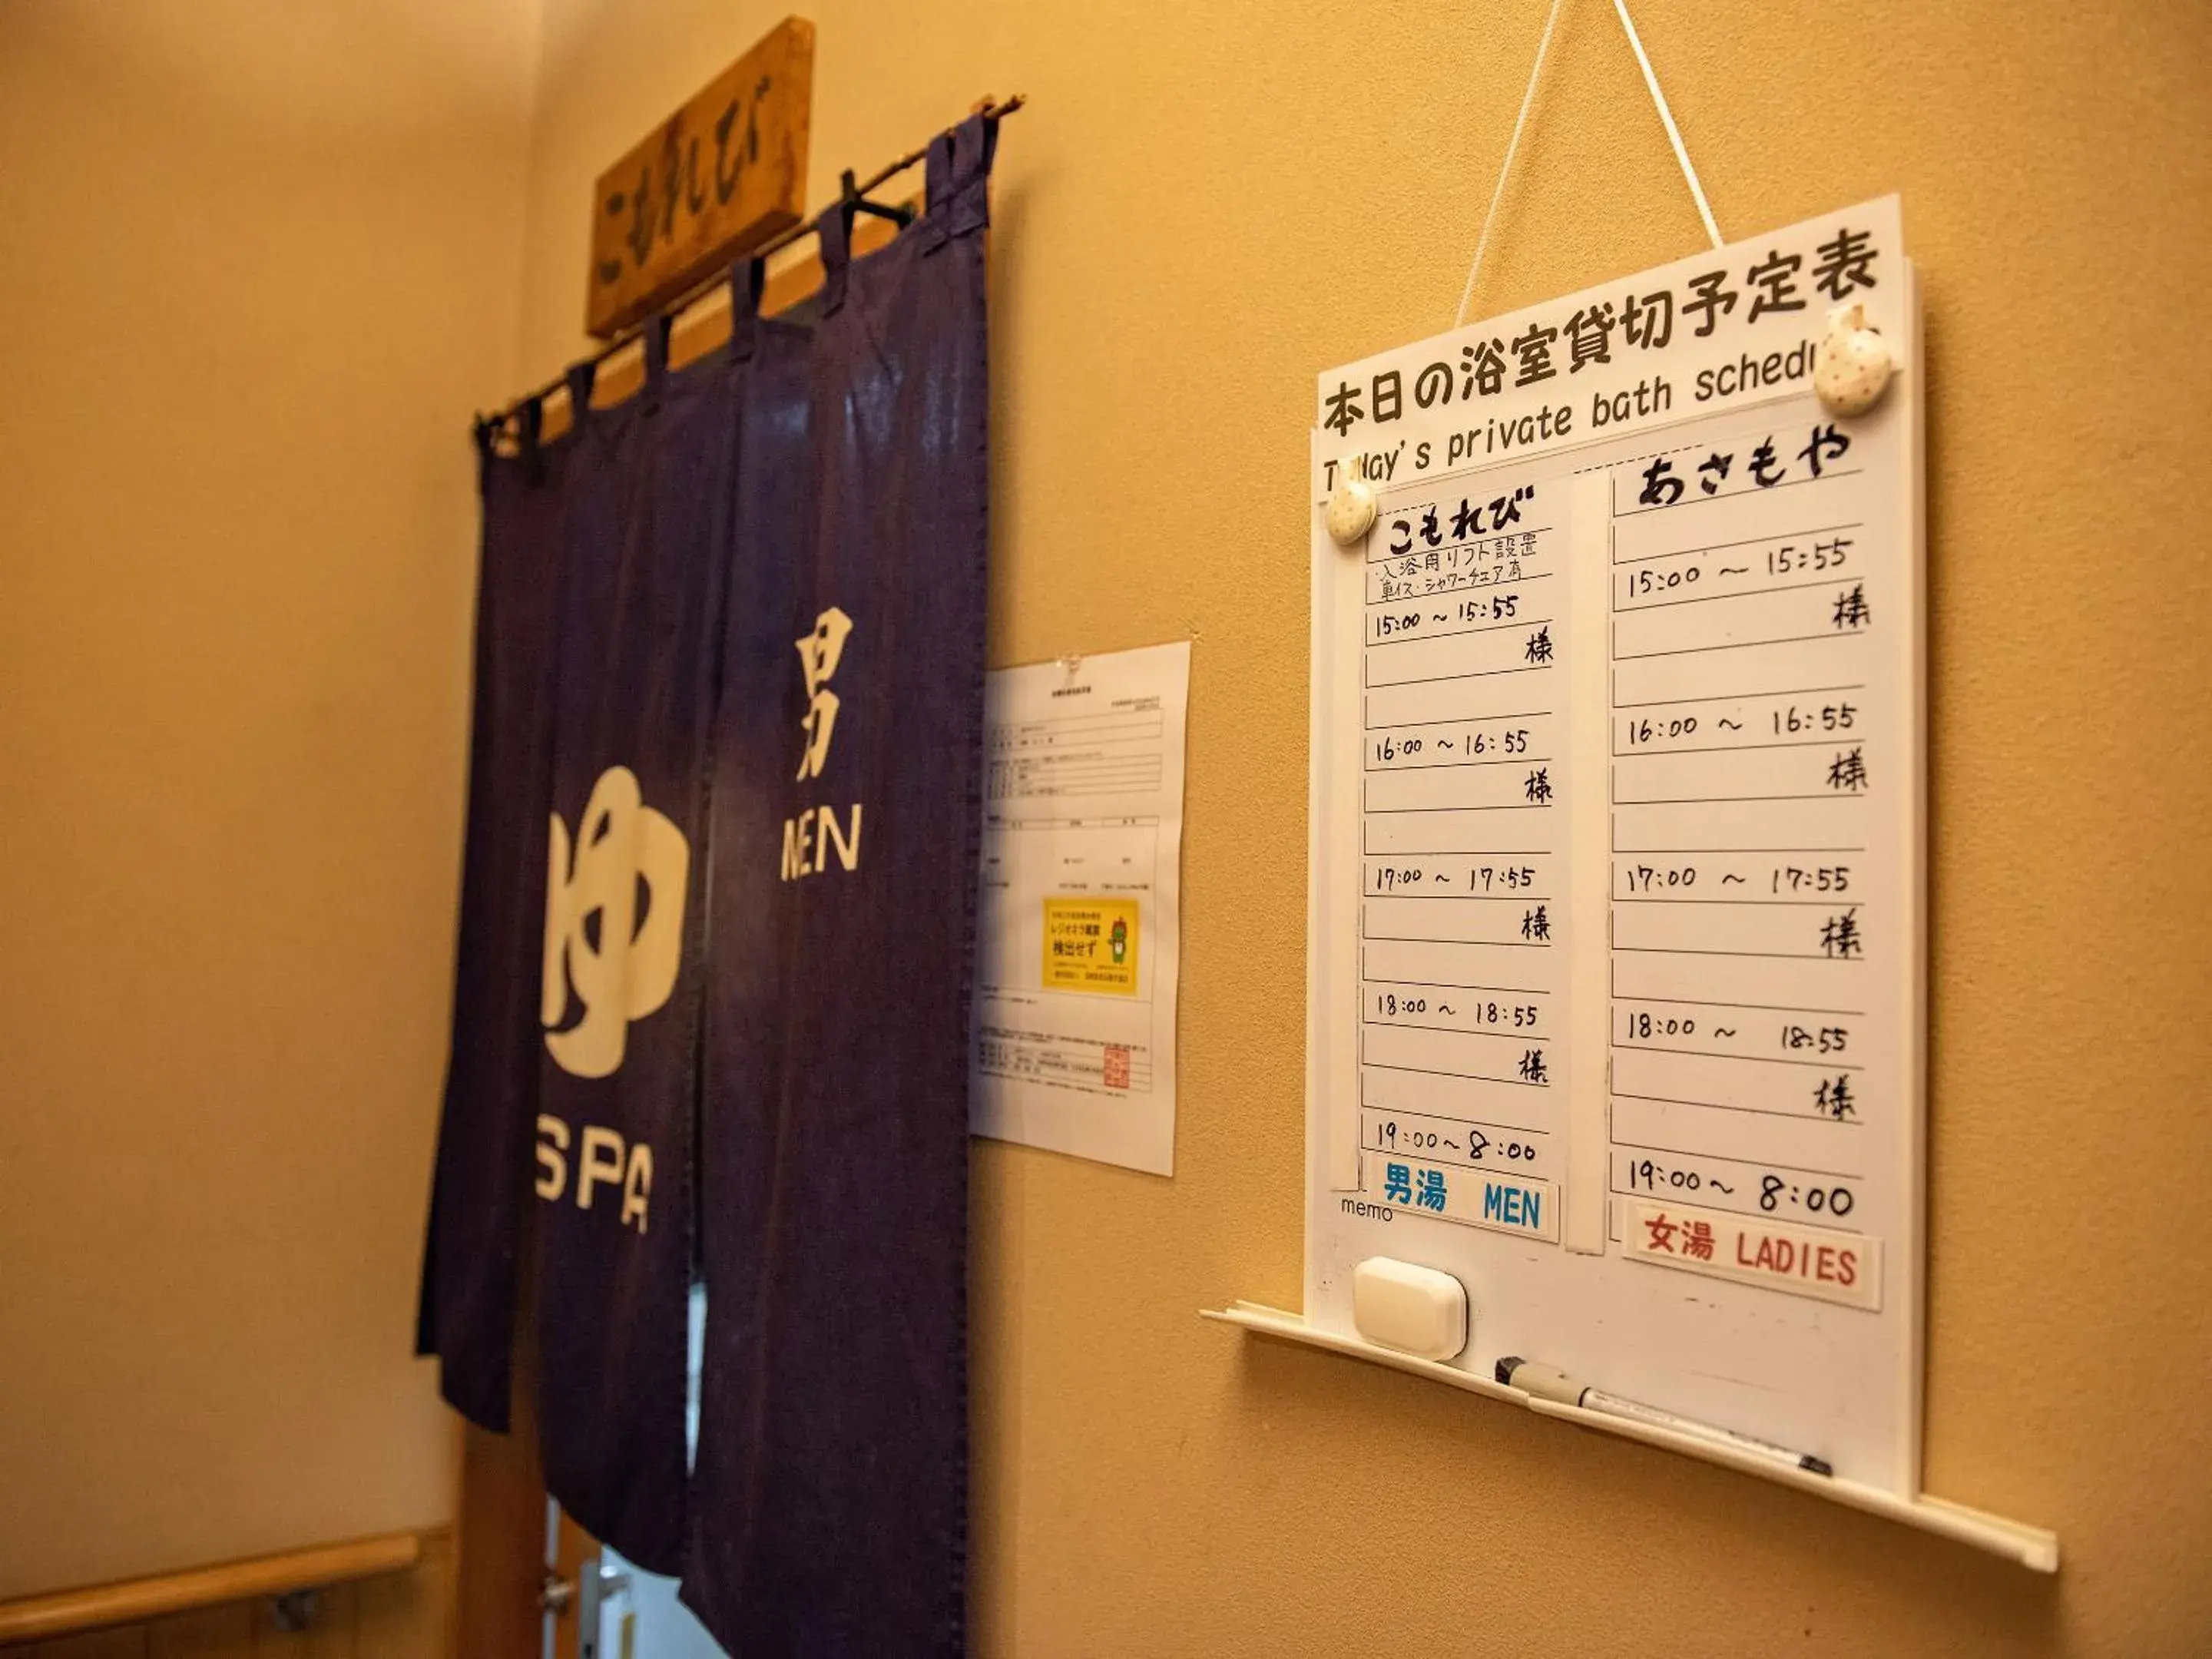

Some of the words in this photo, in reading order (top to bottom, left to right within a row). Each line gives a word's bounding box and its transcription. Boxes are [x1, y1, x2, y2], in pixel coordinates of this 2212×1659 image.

[1323, 228, 1879, 437] 本日の浴室貸切予定表
[1323, 439, 1432, 492] Tay's
[1448, 406, 1573, 466] private
[1591, 376, 1672, 428] bath
[1639, 424, 1852, 505] あさもや
[1390, 485, 1535, 555] こもれび
[1629, 567, 1700, 598] 15:00
[1768, 537, 1854, 575] 15:55
[1377, 613, 1420, 637] 15:00
[1459, 595, 1518, 621] 15:55
[795, 606, 854, 781] 男
[1376, 737, 1422, 761] 16:00
[1466, 730, 1529, 756] 16:55
[1630, 717, 1698, 744] 16:00
[1773, 702, 1857, 735] 16:55
[781, 803, 863, 882] MEN
[1377, 867, 1422, 891] 17:00
[1470, 866, 1535, 891] 17:55
[1628, 865, 1697, 892] 17:00
[1772, 867, 1849, 894] 17:55
[541, 765, 691, 1078] ゆ
[1378, 995, 1426, 1016] 18:00
[1476, 1002, 1537, 1027] 18:55
[1629, 1013, 1696, 1039] 18:00
[1782, 1025, 1849, 1054] 18:55
[535, 1113, 654, 1233] SPA
[1384, 1162, 1448, 1213] 男湯
[1341, 1197, 1393, 1223] memo
[1483, 1183, 1541, 1229] MEN
[1644, 1213, 1717, 1262] 女湯
[1737, 1232, 1858, 1286] LADIES
